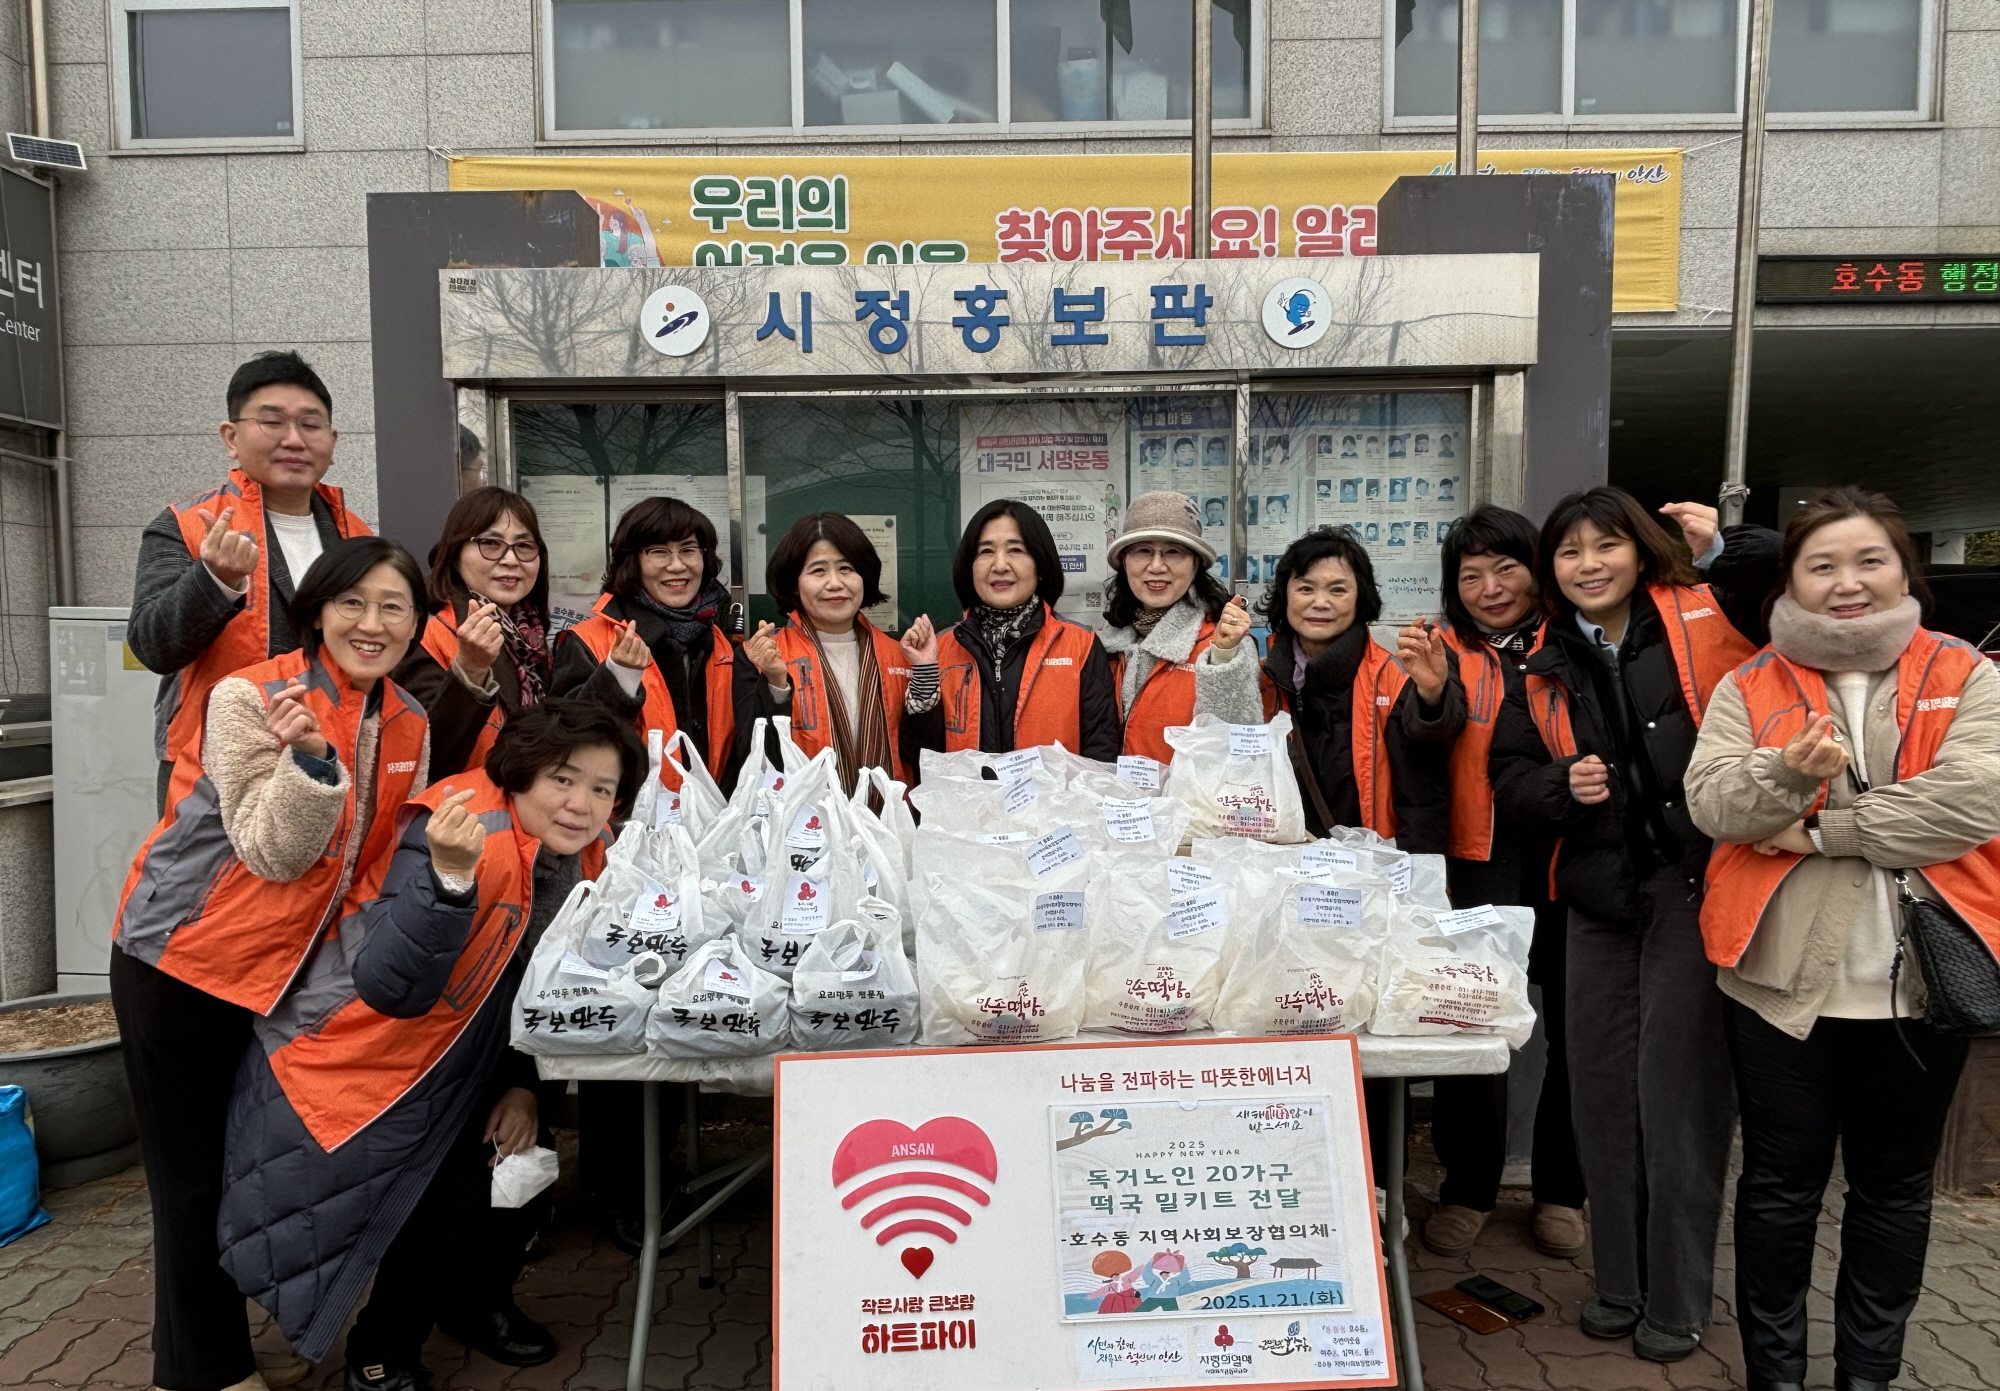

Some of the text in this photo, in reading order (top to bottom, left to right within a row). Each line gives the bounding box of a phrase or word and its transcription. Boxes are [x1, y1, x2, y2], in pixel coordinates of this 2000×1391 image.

[1626, 164, 1671, 183] 안산
[691, 176, 848, 231] 우리의
[1831, 262, 1999, 292] 호수동 행정
[756, 284, 1214, 354] 시정홍보판
[977, 450, 1110, 472] 대국민 서명운동
[606, 923, 688, 961] 국보만두
[818, 990, 854, 1000] 요리만두
[523, 1005, 618, 1034] 국보만두
[672, 1008, 761, 1037] 국보만두
[811, 1008, 900, 1034] 국보만두
[1061, 1064, 1313, 1094] 나눔을 전파하는 따뜻한에너지
[1248, 1120, 1304, 1133] 받으세요
[891, 1142, 935, 1158] ANSAN
[1135, 1151, 1174, 1159] HAPPY
[1169, 1141, 1206, 1150] 2025
[1087, 1163, 1294, 1189] 독거노인 20가구
[1090, 1188, 1302, 1215] 떡국 밀키트 전달
[861, 1294, 976, 1315] 작은사랑 큰보람
[1199, 1289, 1345, 1310] 2025.1.21.(화)
[861, 1319, 977, 1354] 하트파이
[1158, 1350, 1183, 1363] 안산
[1199, 1354, 1253, 1368] 사랑의열매
